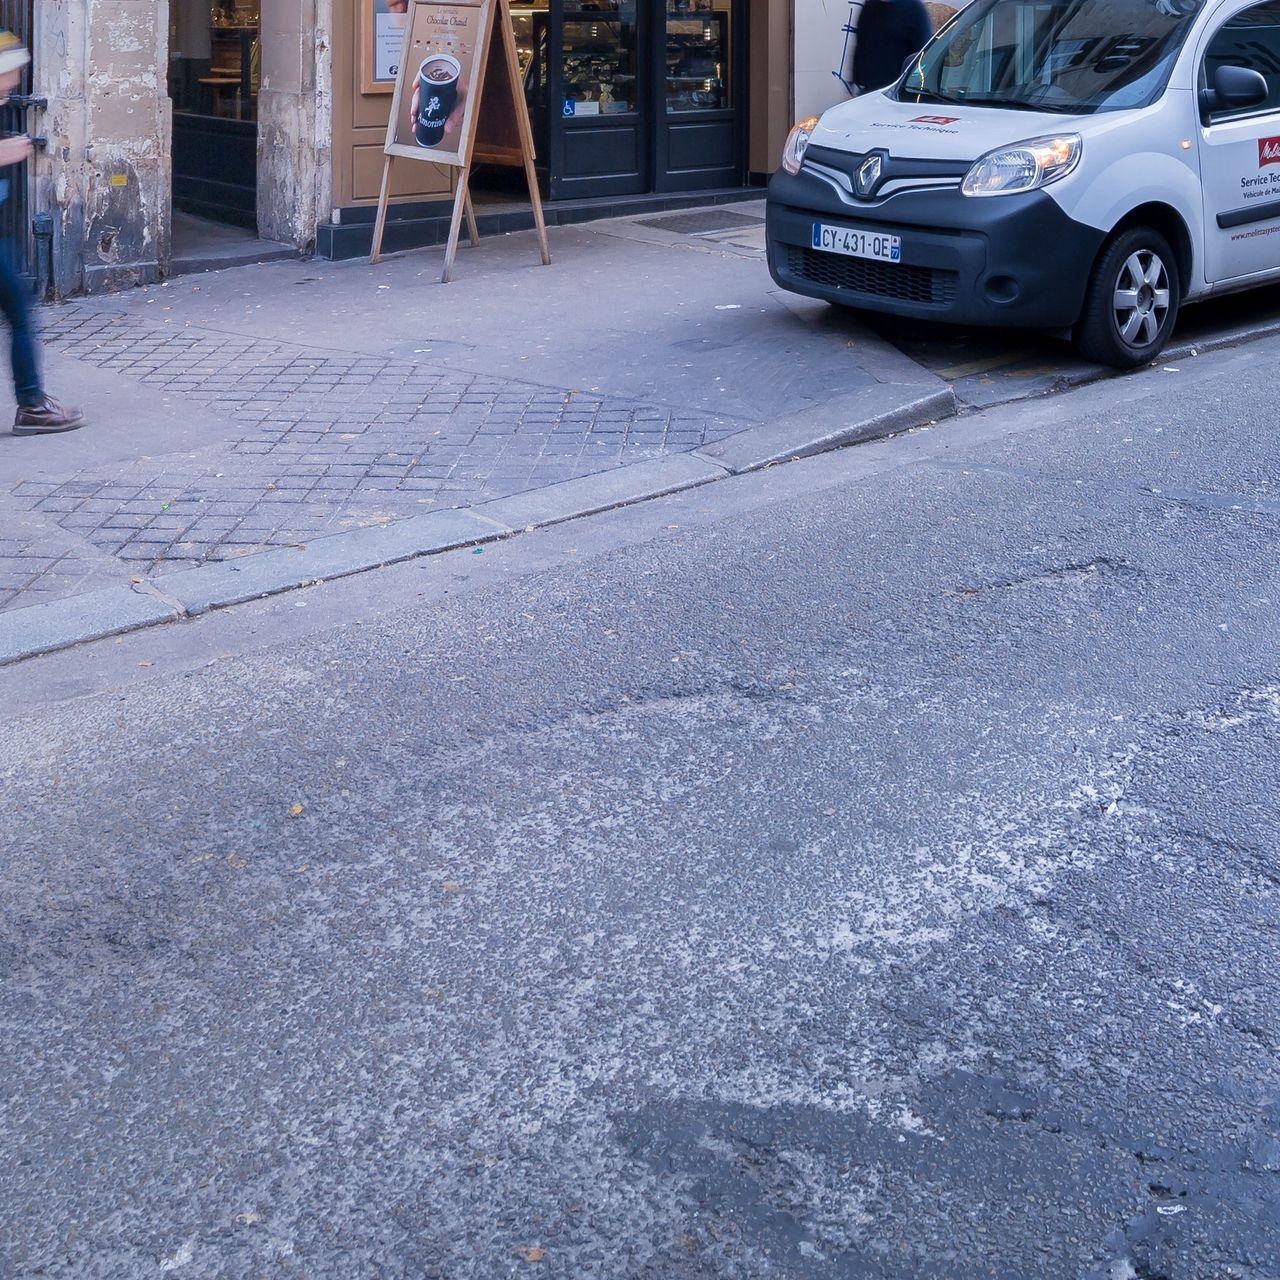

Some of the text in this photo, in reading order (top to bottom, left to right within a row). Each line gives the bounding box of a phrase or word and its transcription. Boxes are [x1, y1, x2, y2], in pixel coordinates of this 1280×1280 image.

[1241, 176, 1268, 188] Service
[1243, 190, 1264, 199] Véhicule
[822, 229, 890, 258] CY-431-QE
